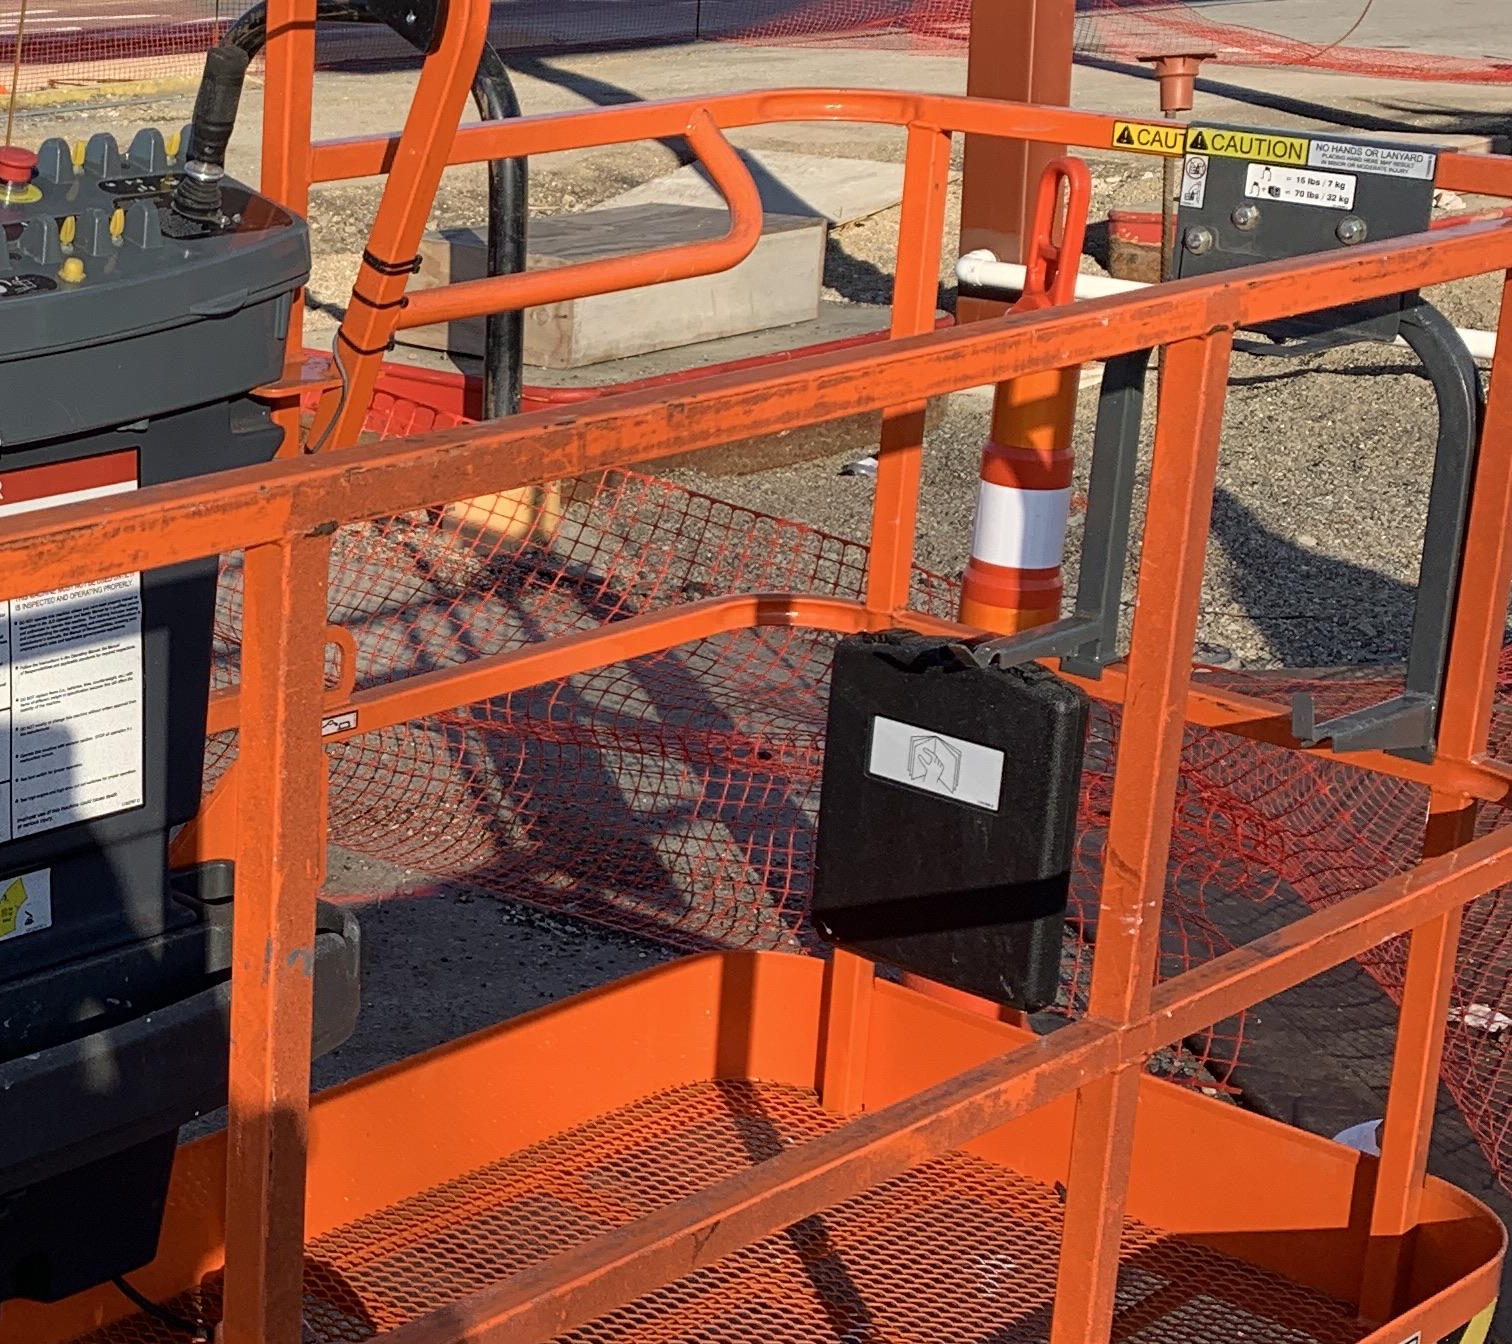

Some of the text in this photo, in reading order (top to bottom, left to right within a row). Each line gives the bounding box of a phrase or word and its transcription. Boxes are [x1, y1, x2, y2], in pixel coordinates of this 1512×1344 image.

[1211, 133, 1303, 161] CAUTION
[1315, 143, 1424, 163] NO HANDS OR LANYARD
[1296, 176, 1306, 184] 15
[1308, 177, 1320, 186] lbs
[1328, 179, 1334, 187] 7
[1335, 180, 1346, 191] kg
[1294, 189, 1305, 198] 70
[1307, 190, 1320, 200] lbs
[1339, 194, 1350, 204] kg
